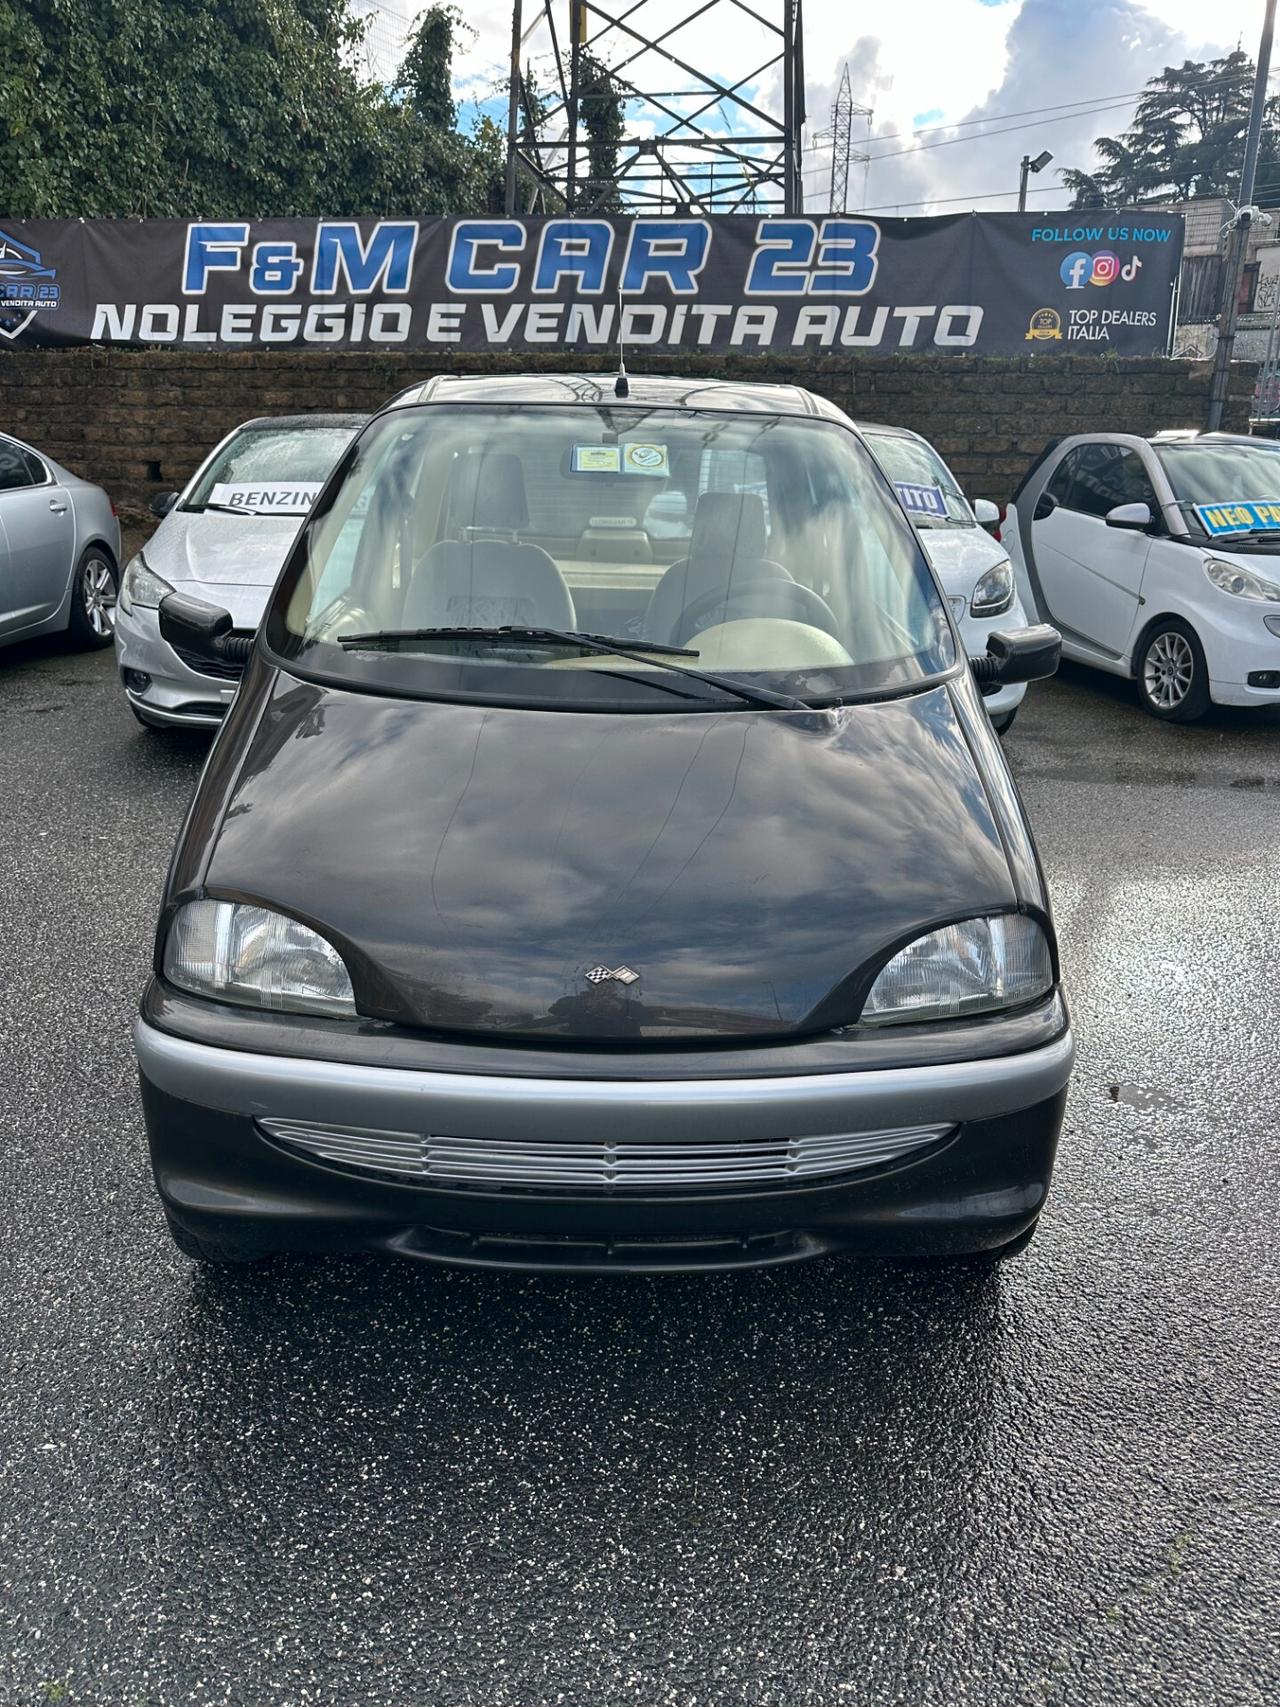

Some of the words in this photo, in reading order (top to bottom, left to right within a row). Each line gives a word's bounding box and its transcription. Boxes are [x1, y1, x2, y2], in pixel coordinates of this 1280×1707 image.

[1031, 227, 1104, 242] FOLLOW
[1108, 227, 1129, 241] US
[1132, 228, 1172, 243] NOW
[182, 221, 420, 296] F&M
[445, 219, 713, 295] CAR
[744, 219, 881, 296] 23
[39, 286, 59, 299] 23
[1, 299, 34, 308] VENDITA
[34, 300, 57, 308] AUTO
[90, 303, 413, 343] NOLEGGIO
[426, 302, 467, 343] E
[481, 303, 778, 346] VENDITA
[791, 305, 984, 347] AUTO
[1069, 309, 1099, 324] TOP
[1101, 310, 1157, 326] DEALERS
[1067, 326, 1110, 340] ITALIA
[229, 491, 317, 506] BENZIN
[1204, 506, 1255, 528] NEO
